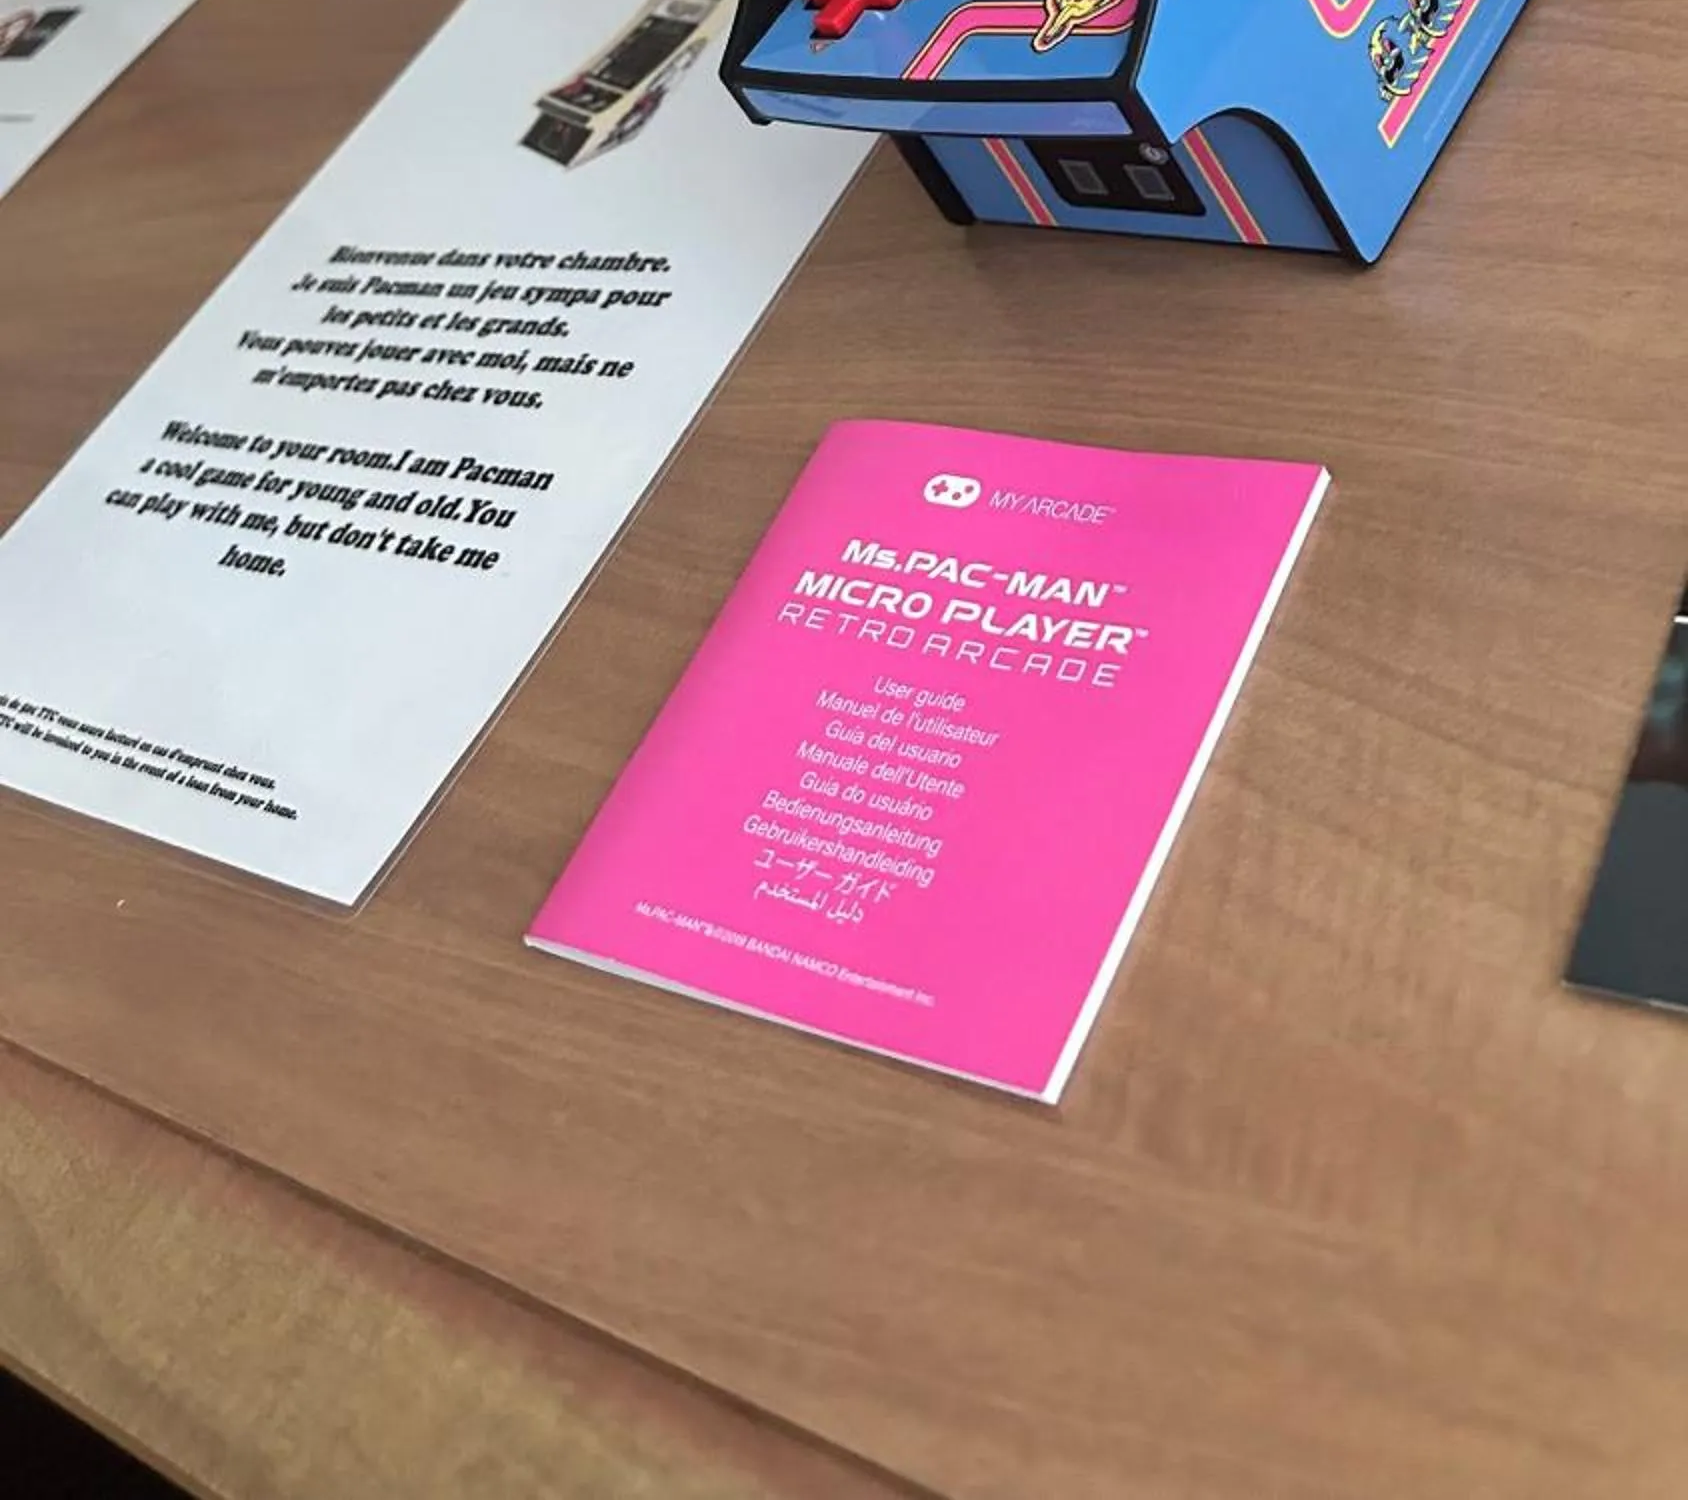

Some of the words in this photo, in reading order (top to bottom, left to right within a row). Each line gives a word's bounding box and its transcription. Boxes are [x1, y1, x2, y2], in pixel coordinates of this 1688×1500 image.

[329, 246, 436, 266] Bienvenue
[436, 249, 491, 268] dans
[495, 253, 555, 269] votre
[557, 251, 671, 273] chambre.
[291, 273, 319, 291] Je
[317, 275, 360, 293] suis
[360, 275, 446, 297] Pacman
[446, 283, 479, 298] un
[475, 280, 520, 304] jeu
[520, 286, 601, 307] sympa
[599, 291, 672, 309] pour
[321, 305, 354, 324] les
[350, 309, 418, 329] petits
[418, 314, 446, 329] et
[444, 312, 481, 331] les
[477, 317, 570, 338] grands.
[238, 330, 286, 350] Vous
[281, 339, 360, 357] pouvez
[354, 339, 423, 362] jouer
[420, 349, 475, 366] avec
[475, 349, 531, 375] moi,
[531, 353, 597, 376] mais
[596, 360, 635, 378] ne
[375, 380, 423, 400] pas
[423, 379, 480, 403] chez
[482, 388, 543, 409] vous.
[160, 419, 248, 451] Welcome
[247, 434, 273, 453] to
[268, 440, 330, 461] your
[407, 457, 451, 478] am
[449, 456, 555, 491] Pacman
[138, 457, 156, 474] a
[154, 459, 205, 481] cool
[193, 466, 256, 489] game
[253, 469, 294, 494] for
[288, 479, 367, 511] young
[363, 490, 419, 514] and
[413, 494, 517, 529] old.You
[988, 490, 1026, 511] MY
[105, 488, 144, 509] can
[136, 491, 190, 520] play
[189, 500, 242, 527] with
[239, 510, 281, 538] me,
[283, 513, 331, 541] but
[327, 522, 395, 552] don't
[394, 533, 456, 563] take
[453, 548, 500, 571] me
[217, 543, 287, 577] home.
[794, 570, 934, 620] MICRO
[777, 602, 916, 650] RETRO
[922, 633, 1122, 688] ARCADE
[815, 690, 881, 720] Manuel
[880, 705, 905, 726] de
[873, 675, 916, 699] User
[914, 687, 966, 712] guide
[36, 705, 60, 722] TTC
[795, 739, 869, 776] Manuale
[870, 760, 966, 798] dell'Utente
[867, 735, 897, 752] del
[898, 740, 962, 769] usuario
[841, 783, 867, 805] do
[761, 789, 944, 859] Bedienungsanleitung
[743, 814, 936, 888] Gebruikershandleiding
[744, 936, 793, 963] BANDAI
[791, 951, 839, 979] NAMCO
